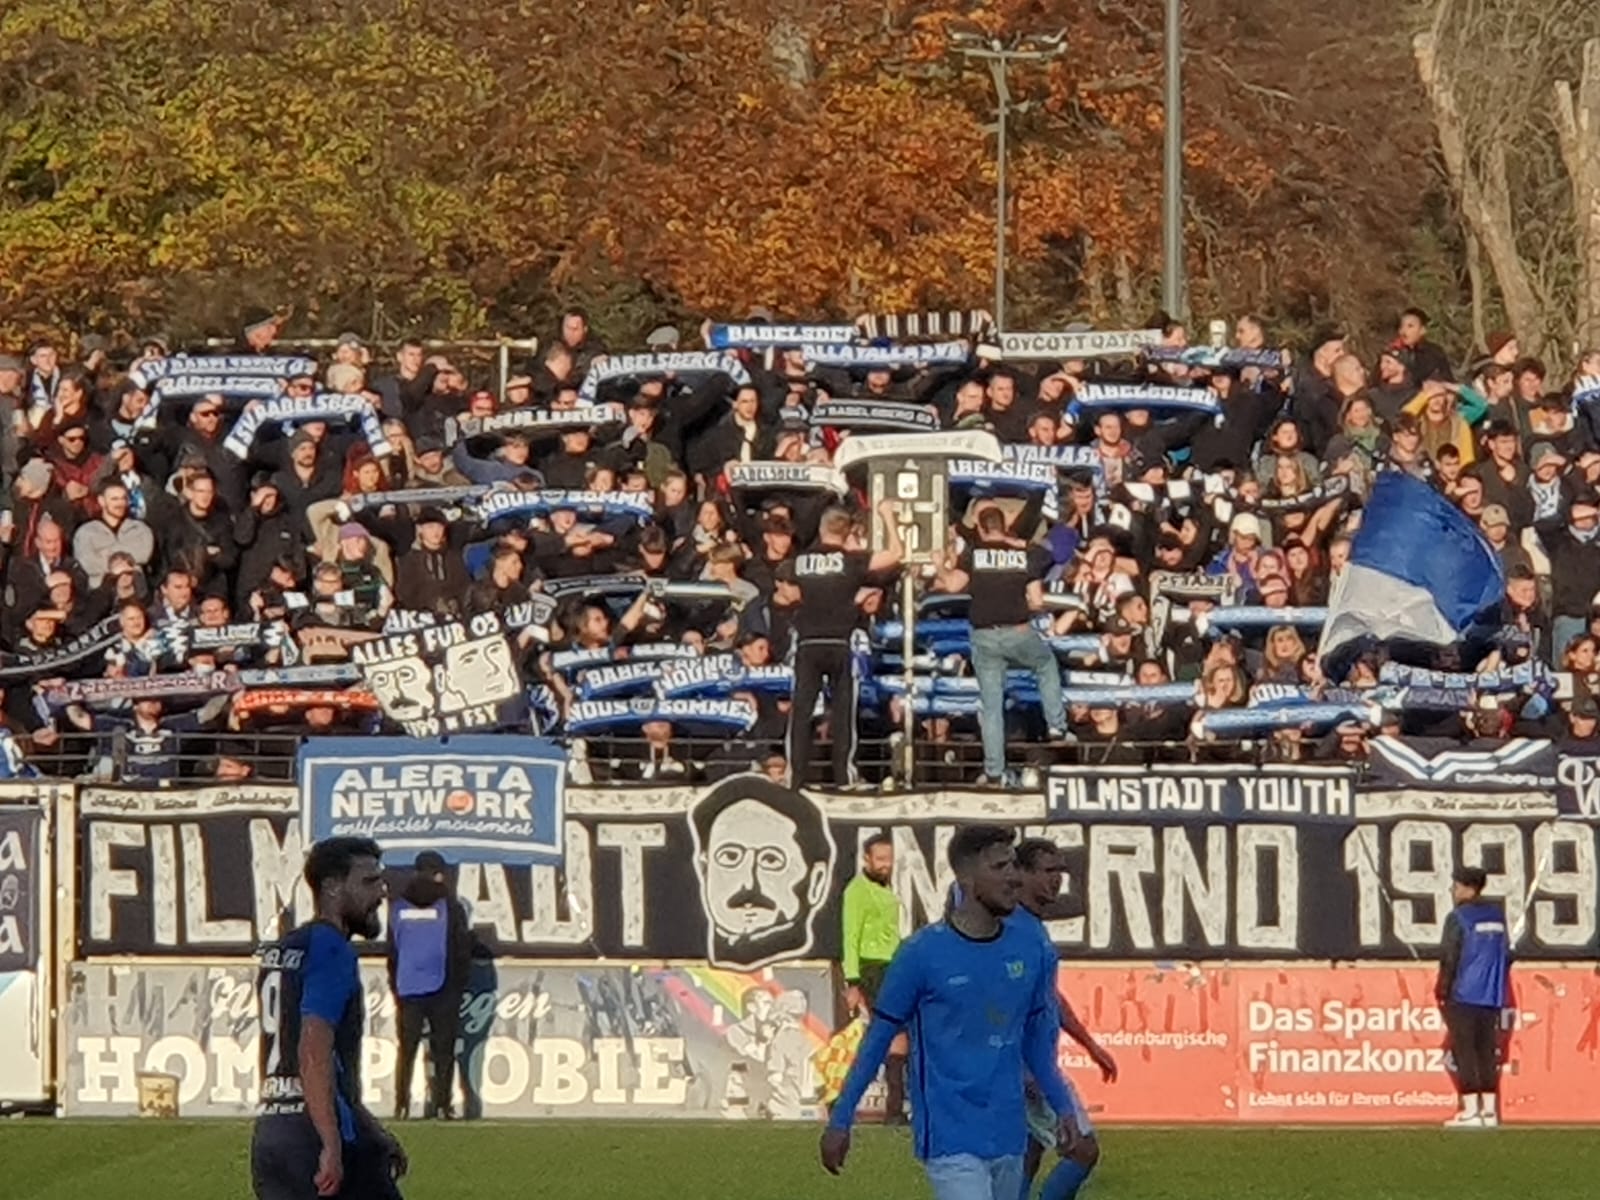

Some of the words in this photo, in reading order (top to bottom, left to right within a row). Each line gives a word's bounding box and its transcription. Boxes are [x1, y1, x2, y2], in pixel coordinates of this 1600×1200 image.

[1001, 332, 1087, 351] OYCOTT
[597, 351, 719, 377] BABELSBERG
[948, 459, 1056, 484] ABELSBE
[333, 763, 532, 792] ALERTA
[330, 789, 534, 821] NETWORK
[1047, 776, 1228, 813] FILMSTADT
[1238, 777, 1352, 817] YOUTH
[1250, 1001, 1313, 1032] Das
